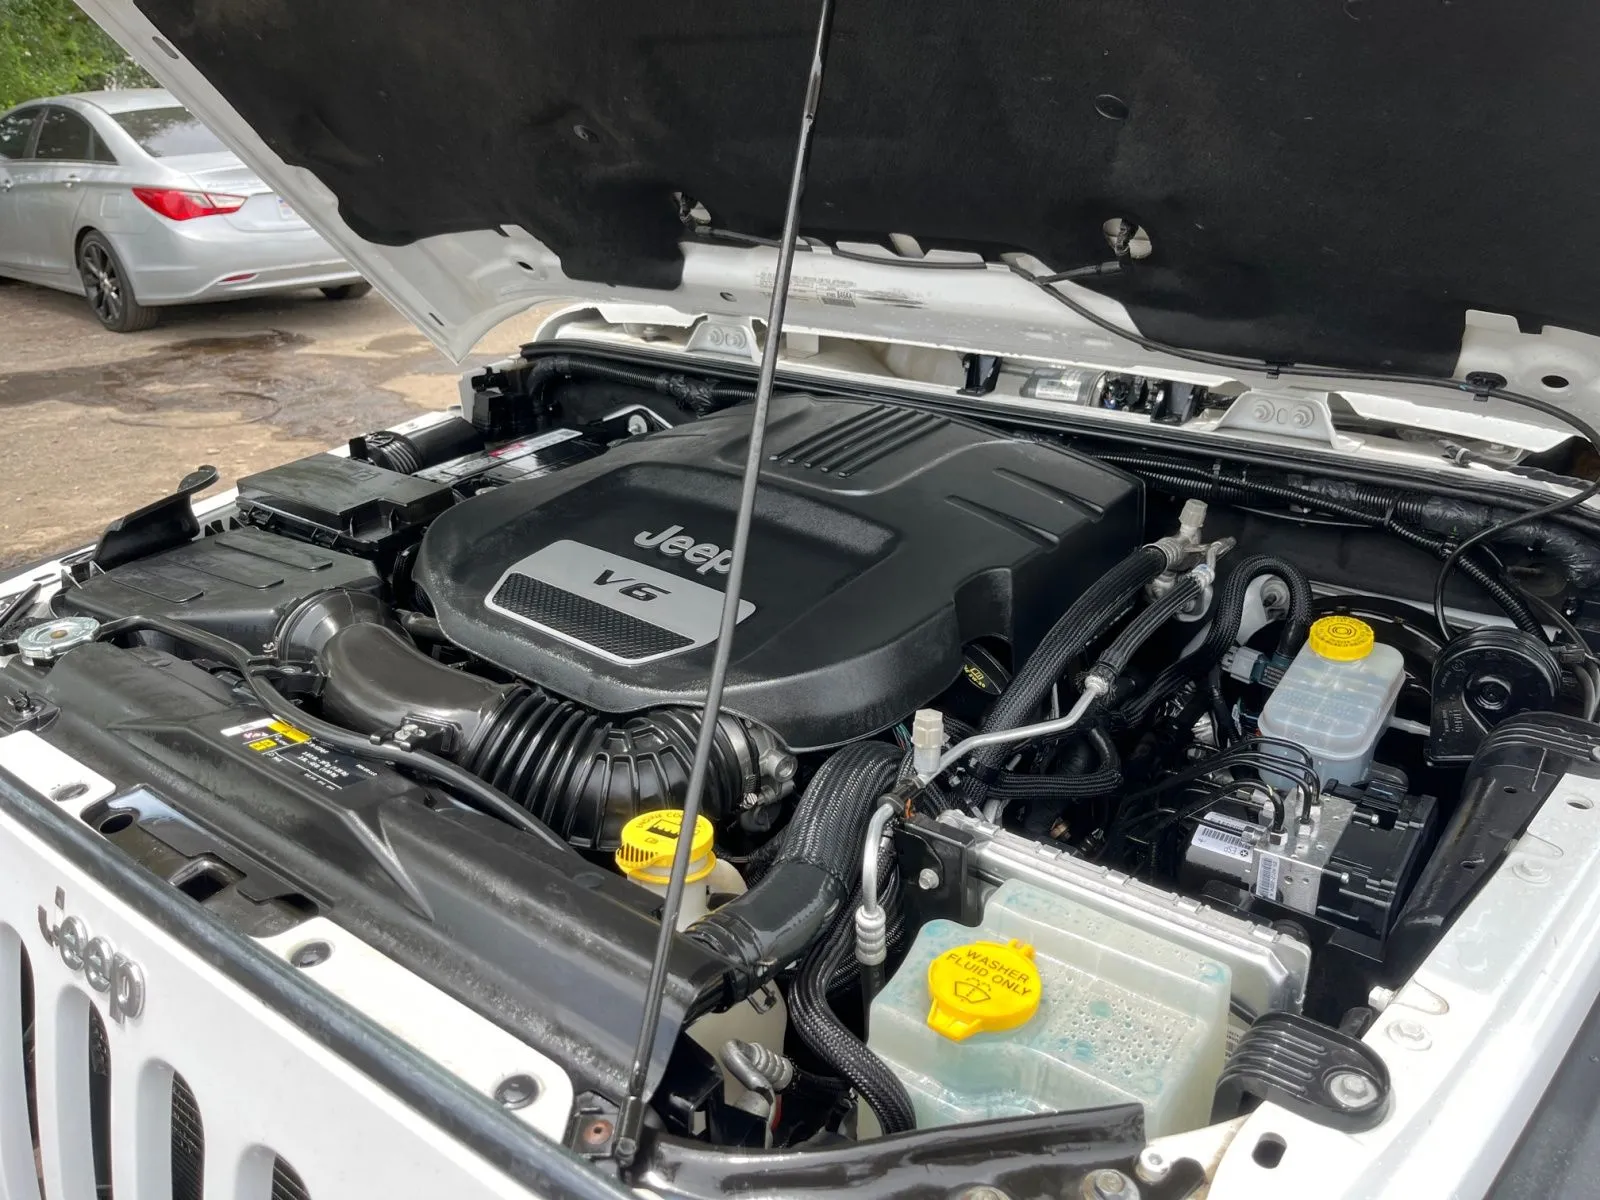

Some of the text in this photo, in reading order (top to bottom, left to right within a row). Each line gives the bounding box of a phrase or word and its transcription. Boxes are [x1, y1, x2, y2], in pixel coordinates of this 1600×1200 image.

[634, 525, 732, 575] Jeep
[593, 569, 672, 602] V6
[37, 885, 147, 1025] Jeep
[946, 953, 1032, 996] FLUID ONLY
[966, 949, 1030, 984] WASHER
